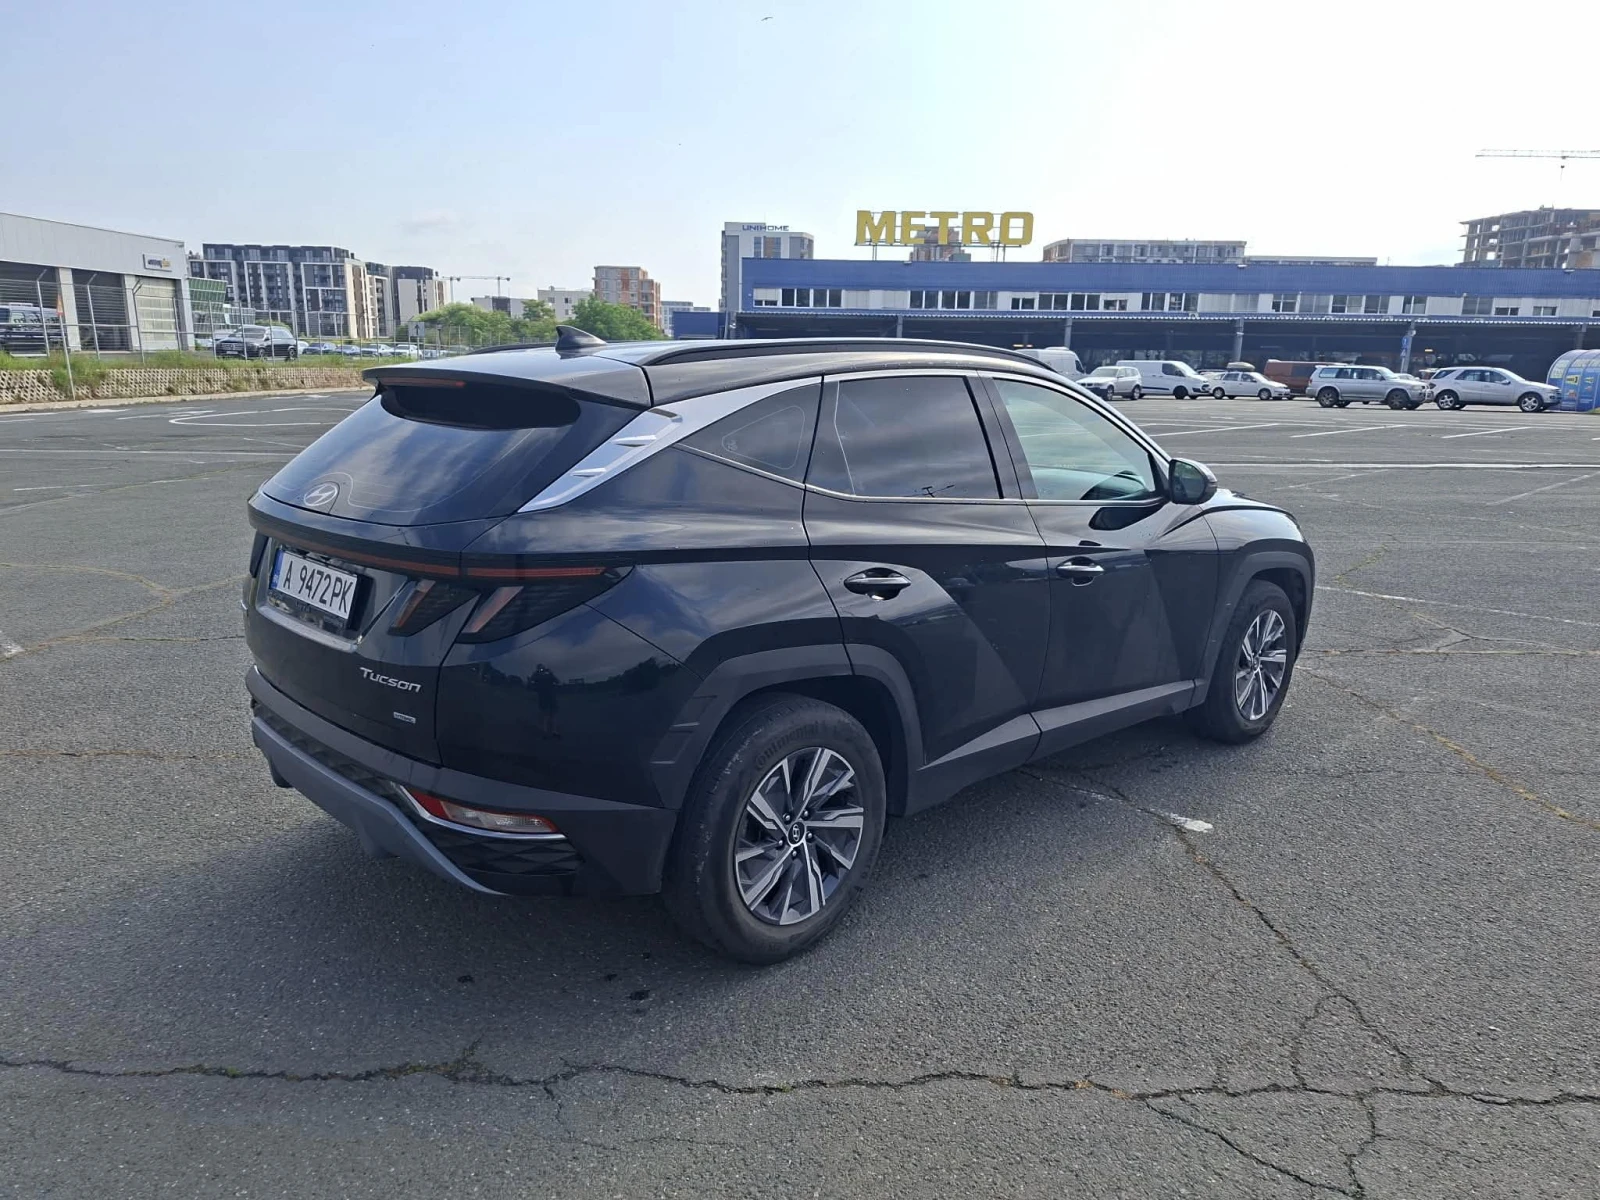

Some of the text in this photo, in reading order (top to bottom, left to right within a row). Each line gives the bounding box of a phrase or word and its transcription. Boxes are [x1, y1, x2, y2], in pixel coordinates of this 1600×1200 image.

[742, 224, 789, 232] UNIHOME
[857, 210, 1034, 246] METRO
[283, 560, 293, 590] A
